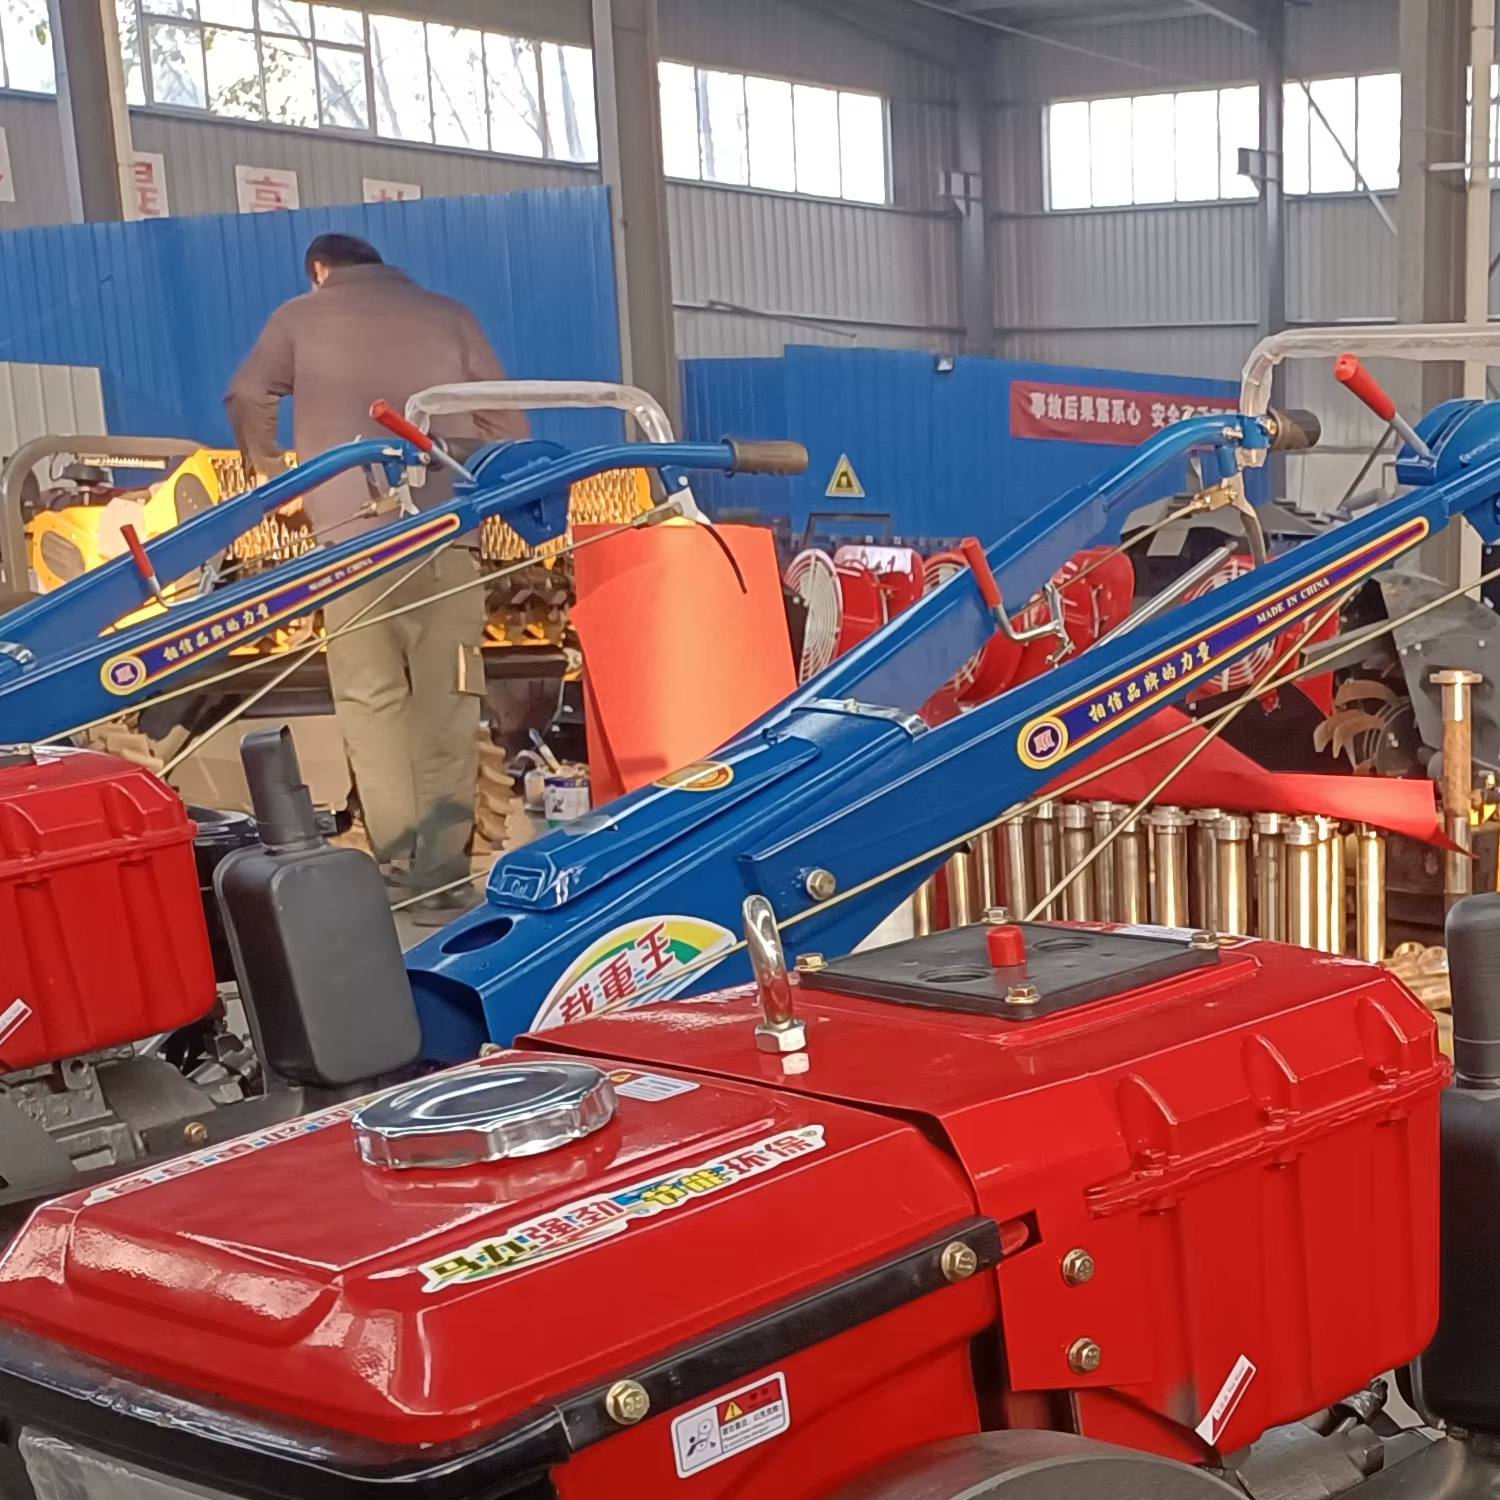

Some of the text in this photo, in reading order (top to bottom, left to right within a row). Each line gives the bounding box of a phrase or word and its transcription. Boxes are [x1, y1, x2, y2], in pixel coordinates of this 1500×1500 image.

[1255, 576, 1331, 625] MADE IN CHINA
[1088, 641, 1213, 724] 相信品牌的力量
